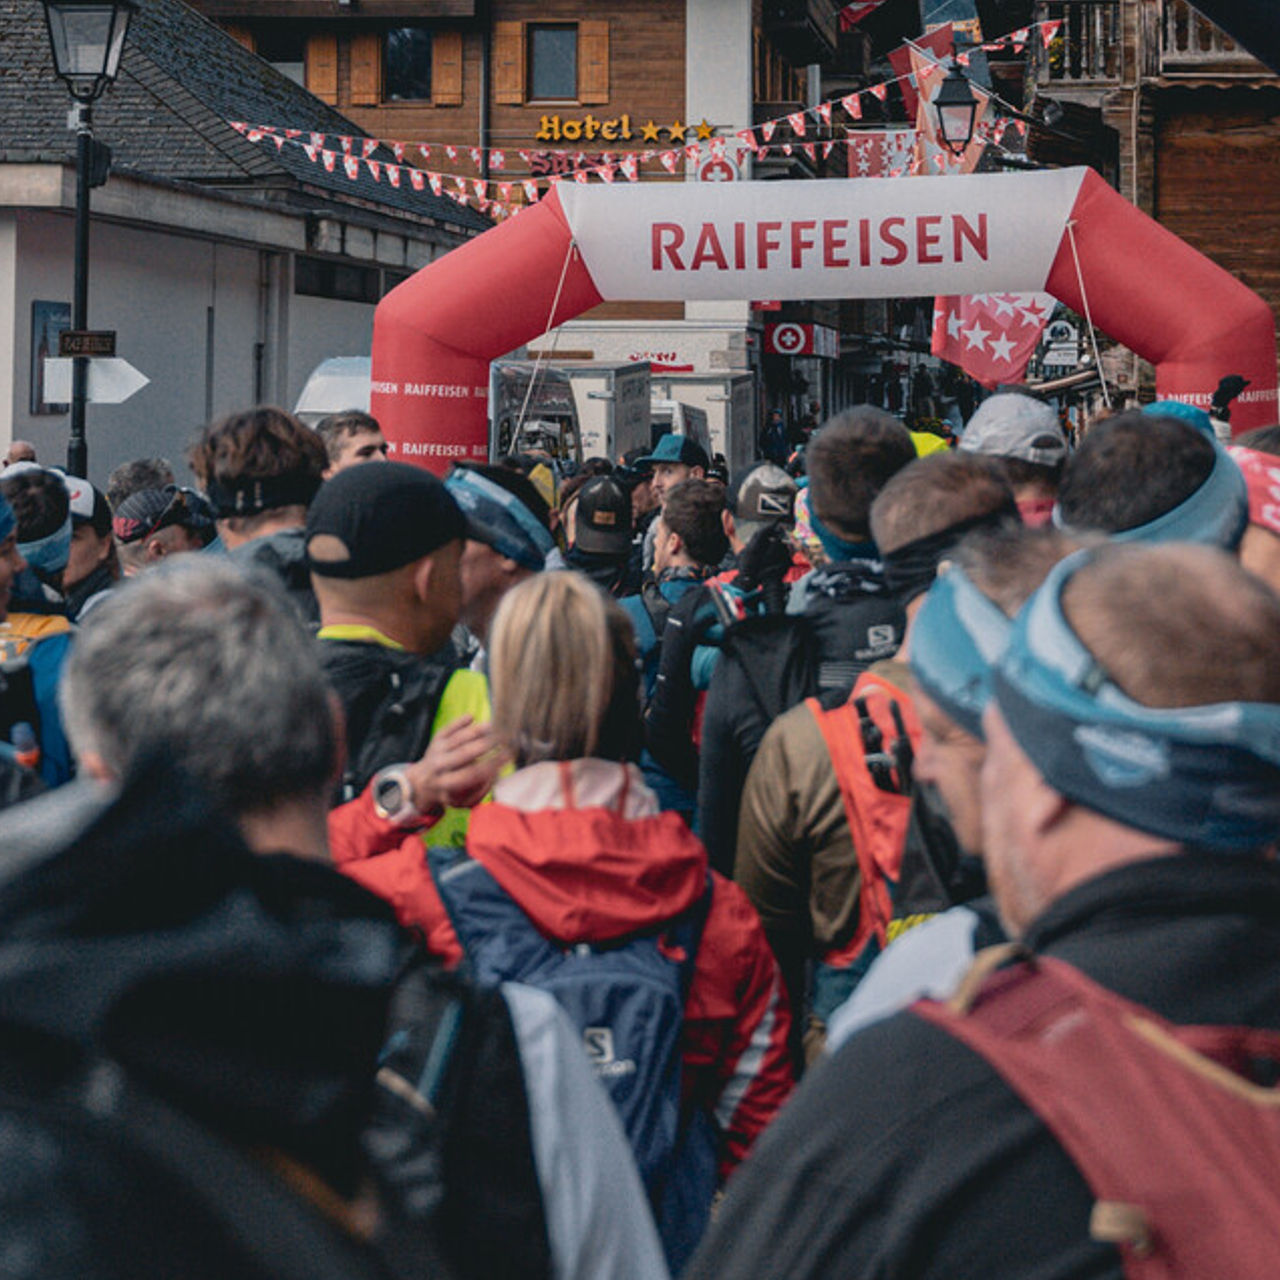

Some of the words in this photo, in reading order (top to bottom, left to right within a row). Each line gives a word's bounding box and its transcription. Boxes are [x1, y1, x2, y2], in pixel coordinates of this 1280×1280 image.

[536, 114, 632, 141] Hotel
[651, 213, 988, 271] RAIFFEISEN
[404, 383, 469, 398] RAIFFEISEN
[402, 442, 467, 457] RAIFFEISEN
